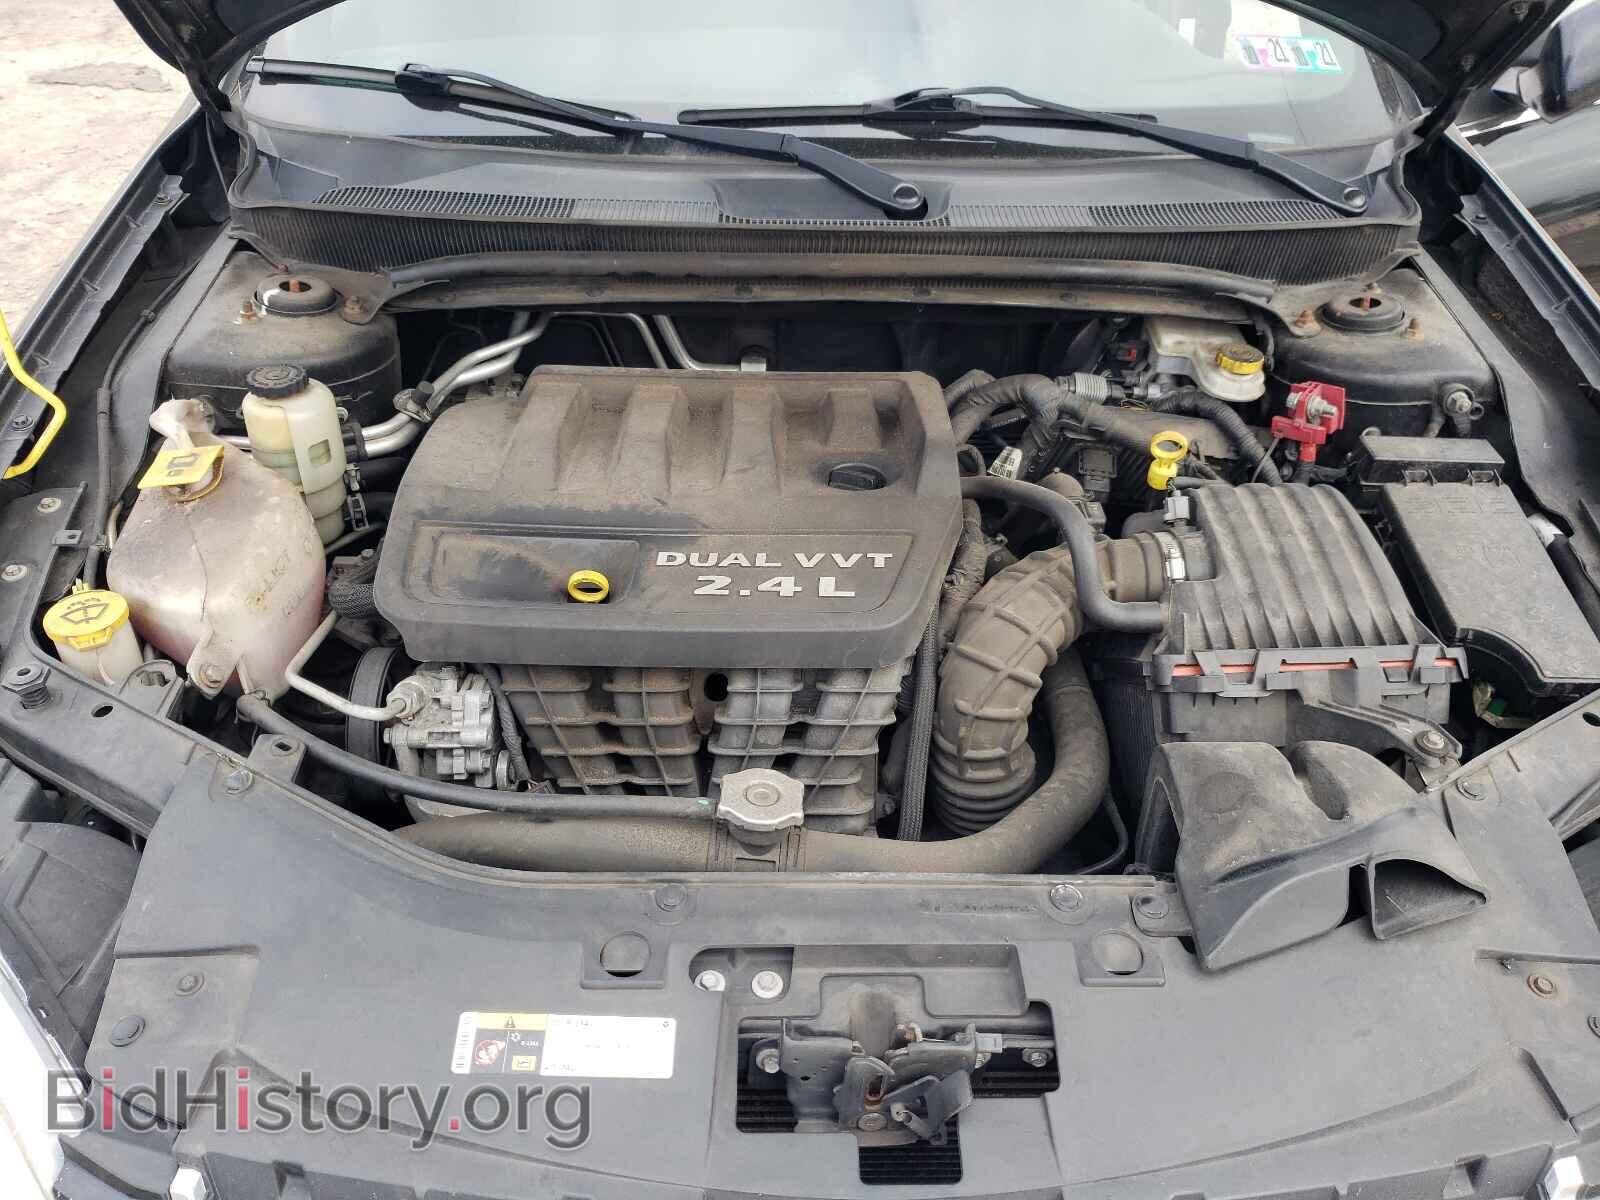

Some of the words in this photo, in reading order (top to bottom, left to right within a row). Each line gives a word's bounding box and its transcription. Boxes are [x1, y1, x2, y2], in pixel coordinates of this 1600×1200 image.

[1266, 38, 1290, 63] 21
[1313, 40, 1337, 66] 21
[656, 551, 782, 568] DUAL
[794, 552, 894, 569] VVT
